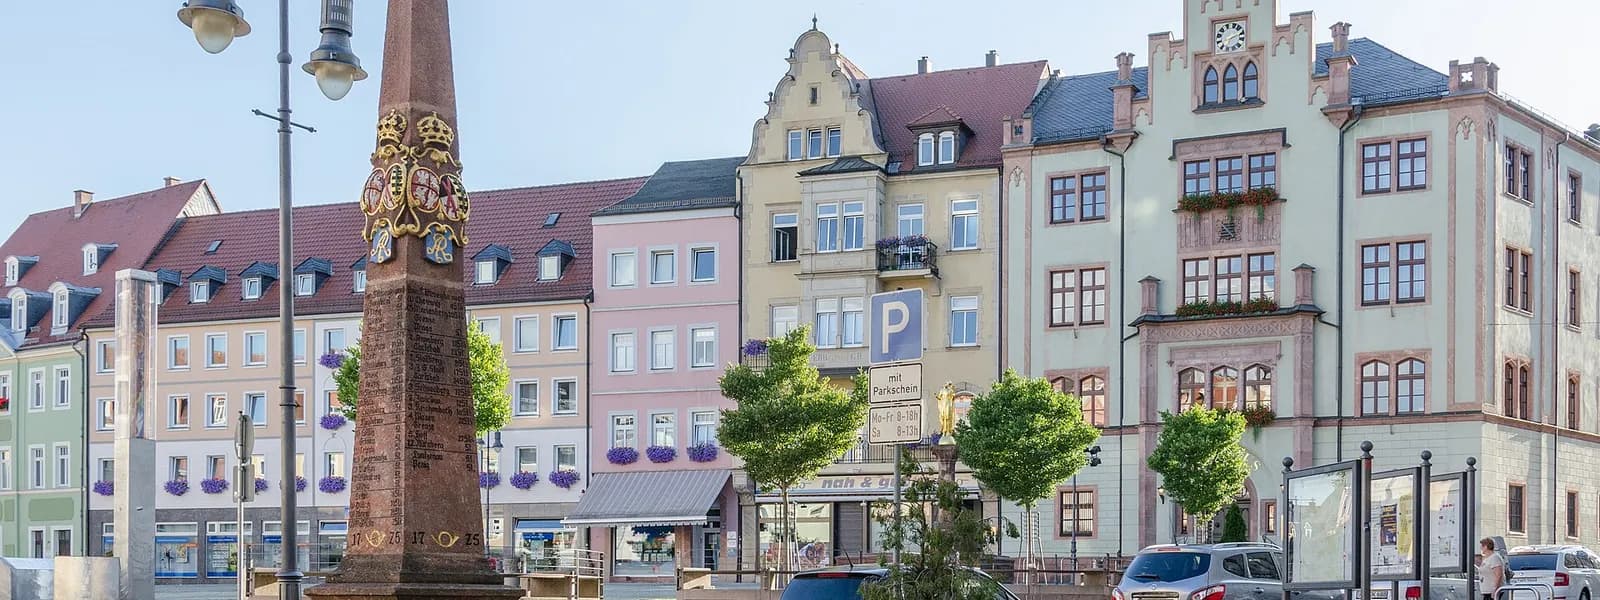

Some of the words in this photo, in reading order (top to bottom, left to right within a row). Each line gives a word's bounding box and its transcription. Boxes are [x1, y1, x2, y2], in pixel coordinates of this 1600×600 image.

[882, 301, 910, 354] P
[888, 373, 902, 383] mit
[873, 384, 917, 396] Parkschein
[872, 411, 893, 423] Mo-Fr
[896, 410, 918, 421] 8-18h
[872, 427, 880, 438] Sa
[896, 425, 918, 437] 8-13h
[822, 477, 854, 488] nah
[860, 477, 872, 488] &
[411, 532, 425, 544] 17
